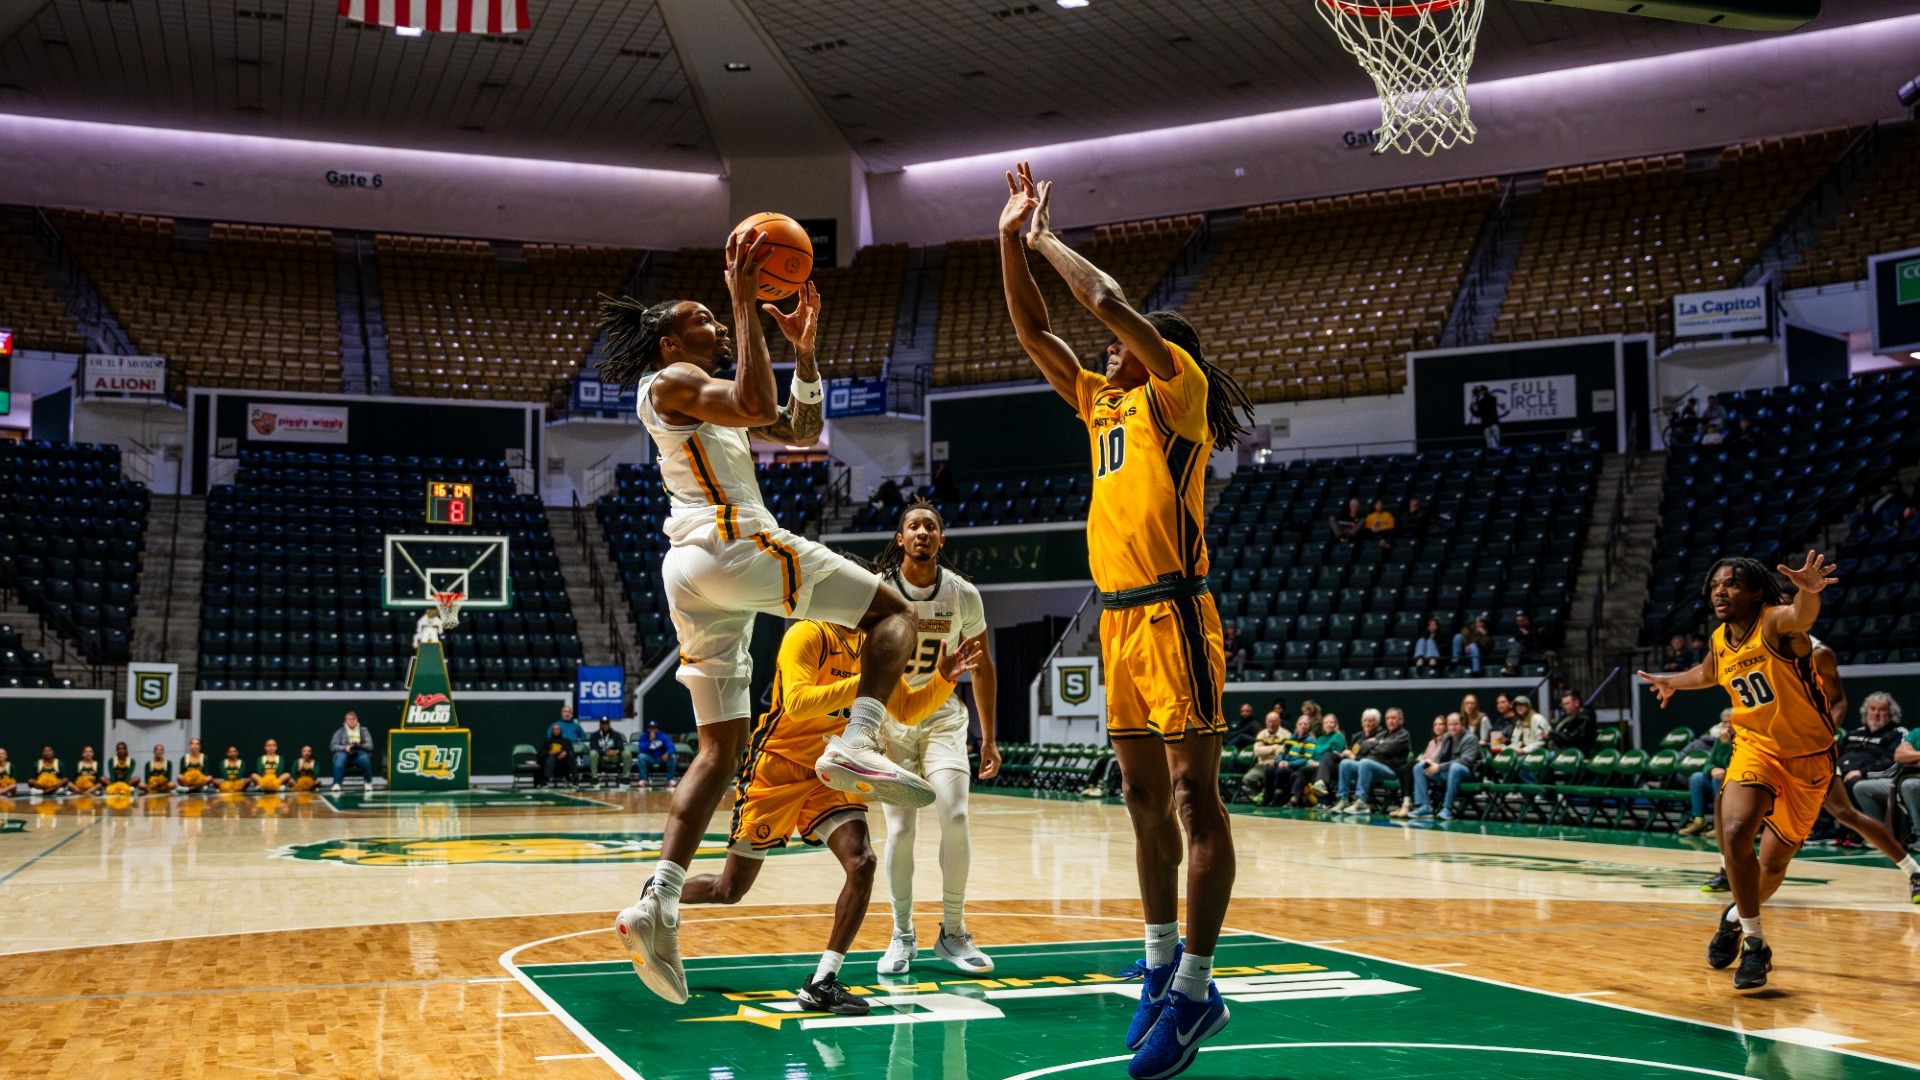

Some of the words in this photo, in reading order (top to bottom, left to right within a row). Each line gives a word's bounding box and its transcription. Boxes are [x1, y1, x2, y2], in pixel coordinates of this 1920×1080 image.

[326, 170, 367, 186] Gate
[372, 174, 382, 188] 6
[1679, 302, 1698, 316] La
[1702, 296, 1761, 316] Capitol
[95, 377, 108, 389] A
[110, 377, 157, 391] LION!
[278, 416, 308, 429] piggly
[311, 417, 344, 430] wiggly
[1096, 426, 1126, 480] 10
[448, 500, 465, 523] 8
[1738, 655, 1766, 669] TEXAS
[142, 678, 162, 700] S
[580, 680, 622, 699] FGB
[1066, 673, 1085, 696] S
[1730, 670, 1776, 709] 30
